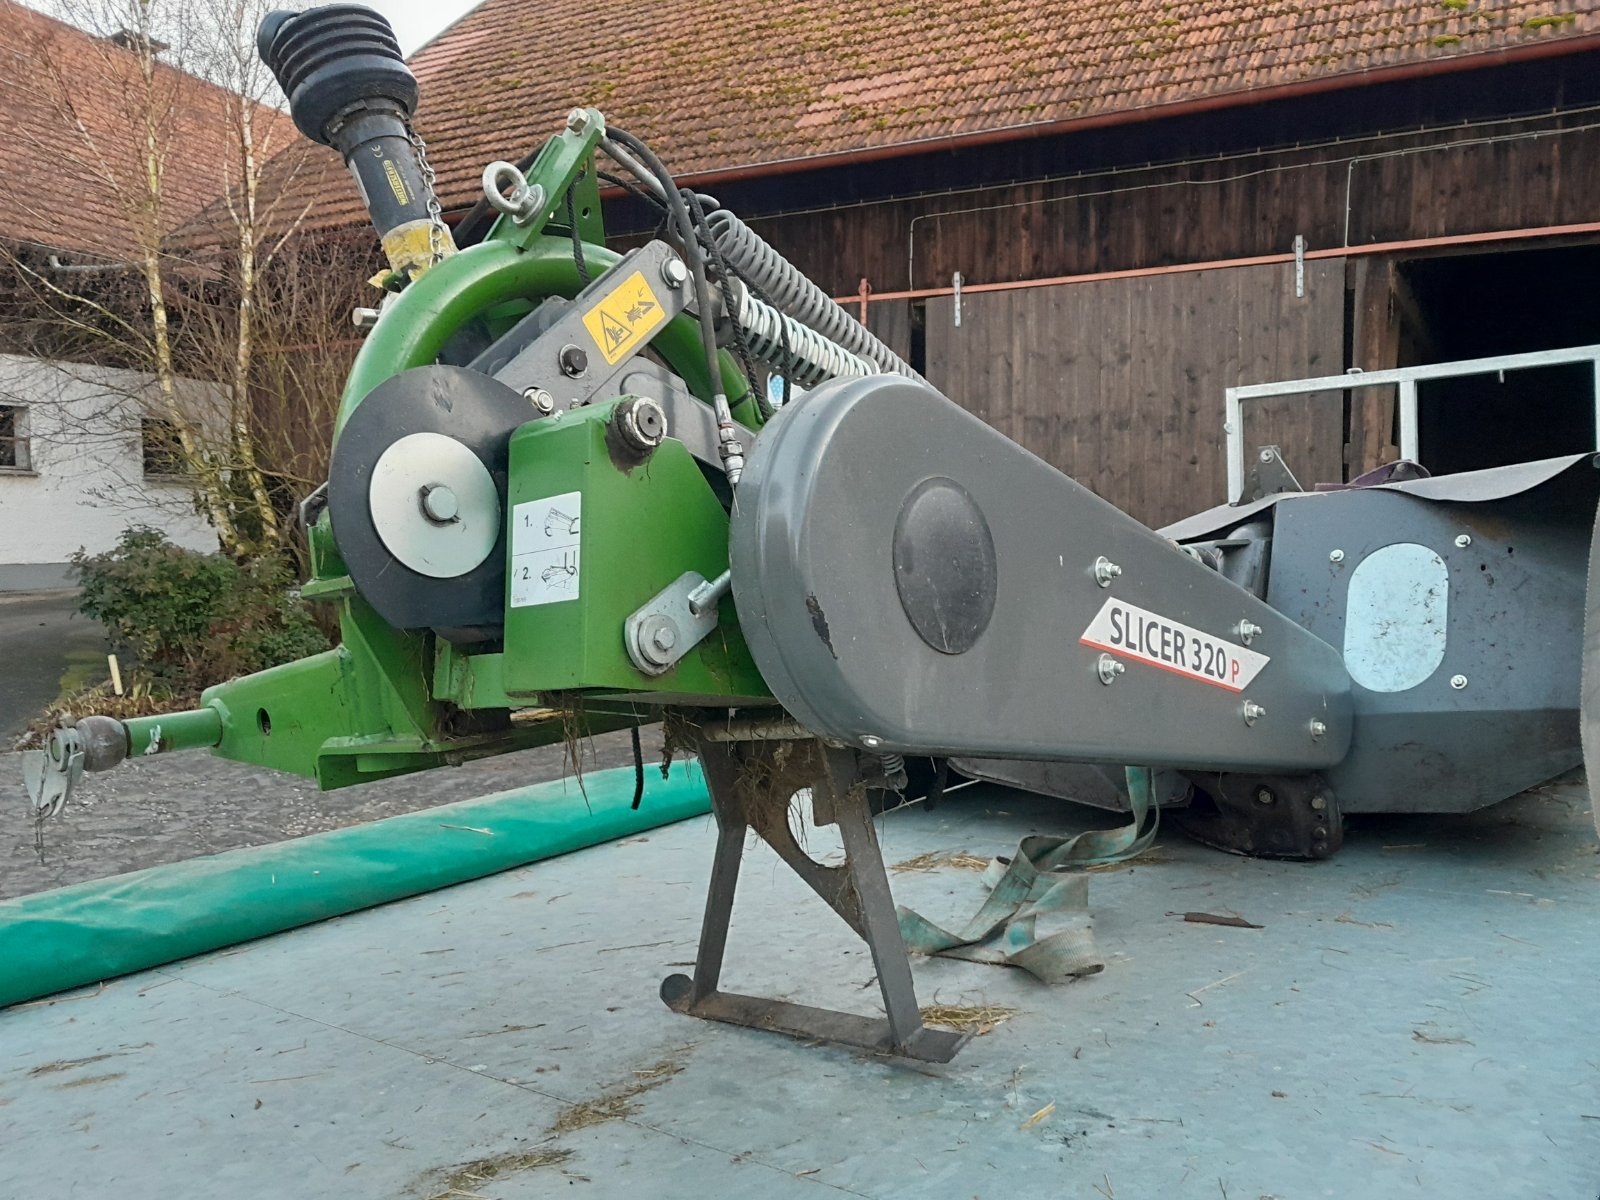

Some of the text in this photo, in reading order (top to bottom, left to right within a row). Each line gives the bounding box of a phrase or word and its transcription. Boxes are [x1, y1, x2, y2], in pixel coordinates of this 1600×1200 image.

[1110, 607, 1240, 683] SLICER 320 P
